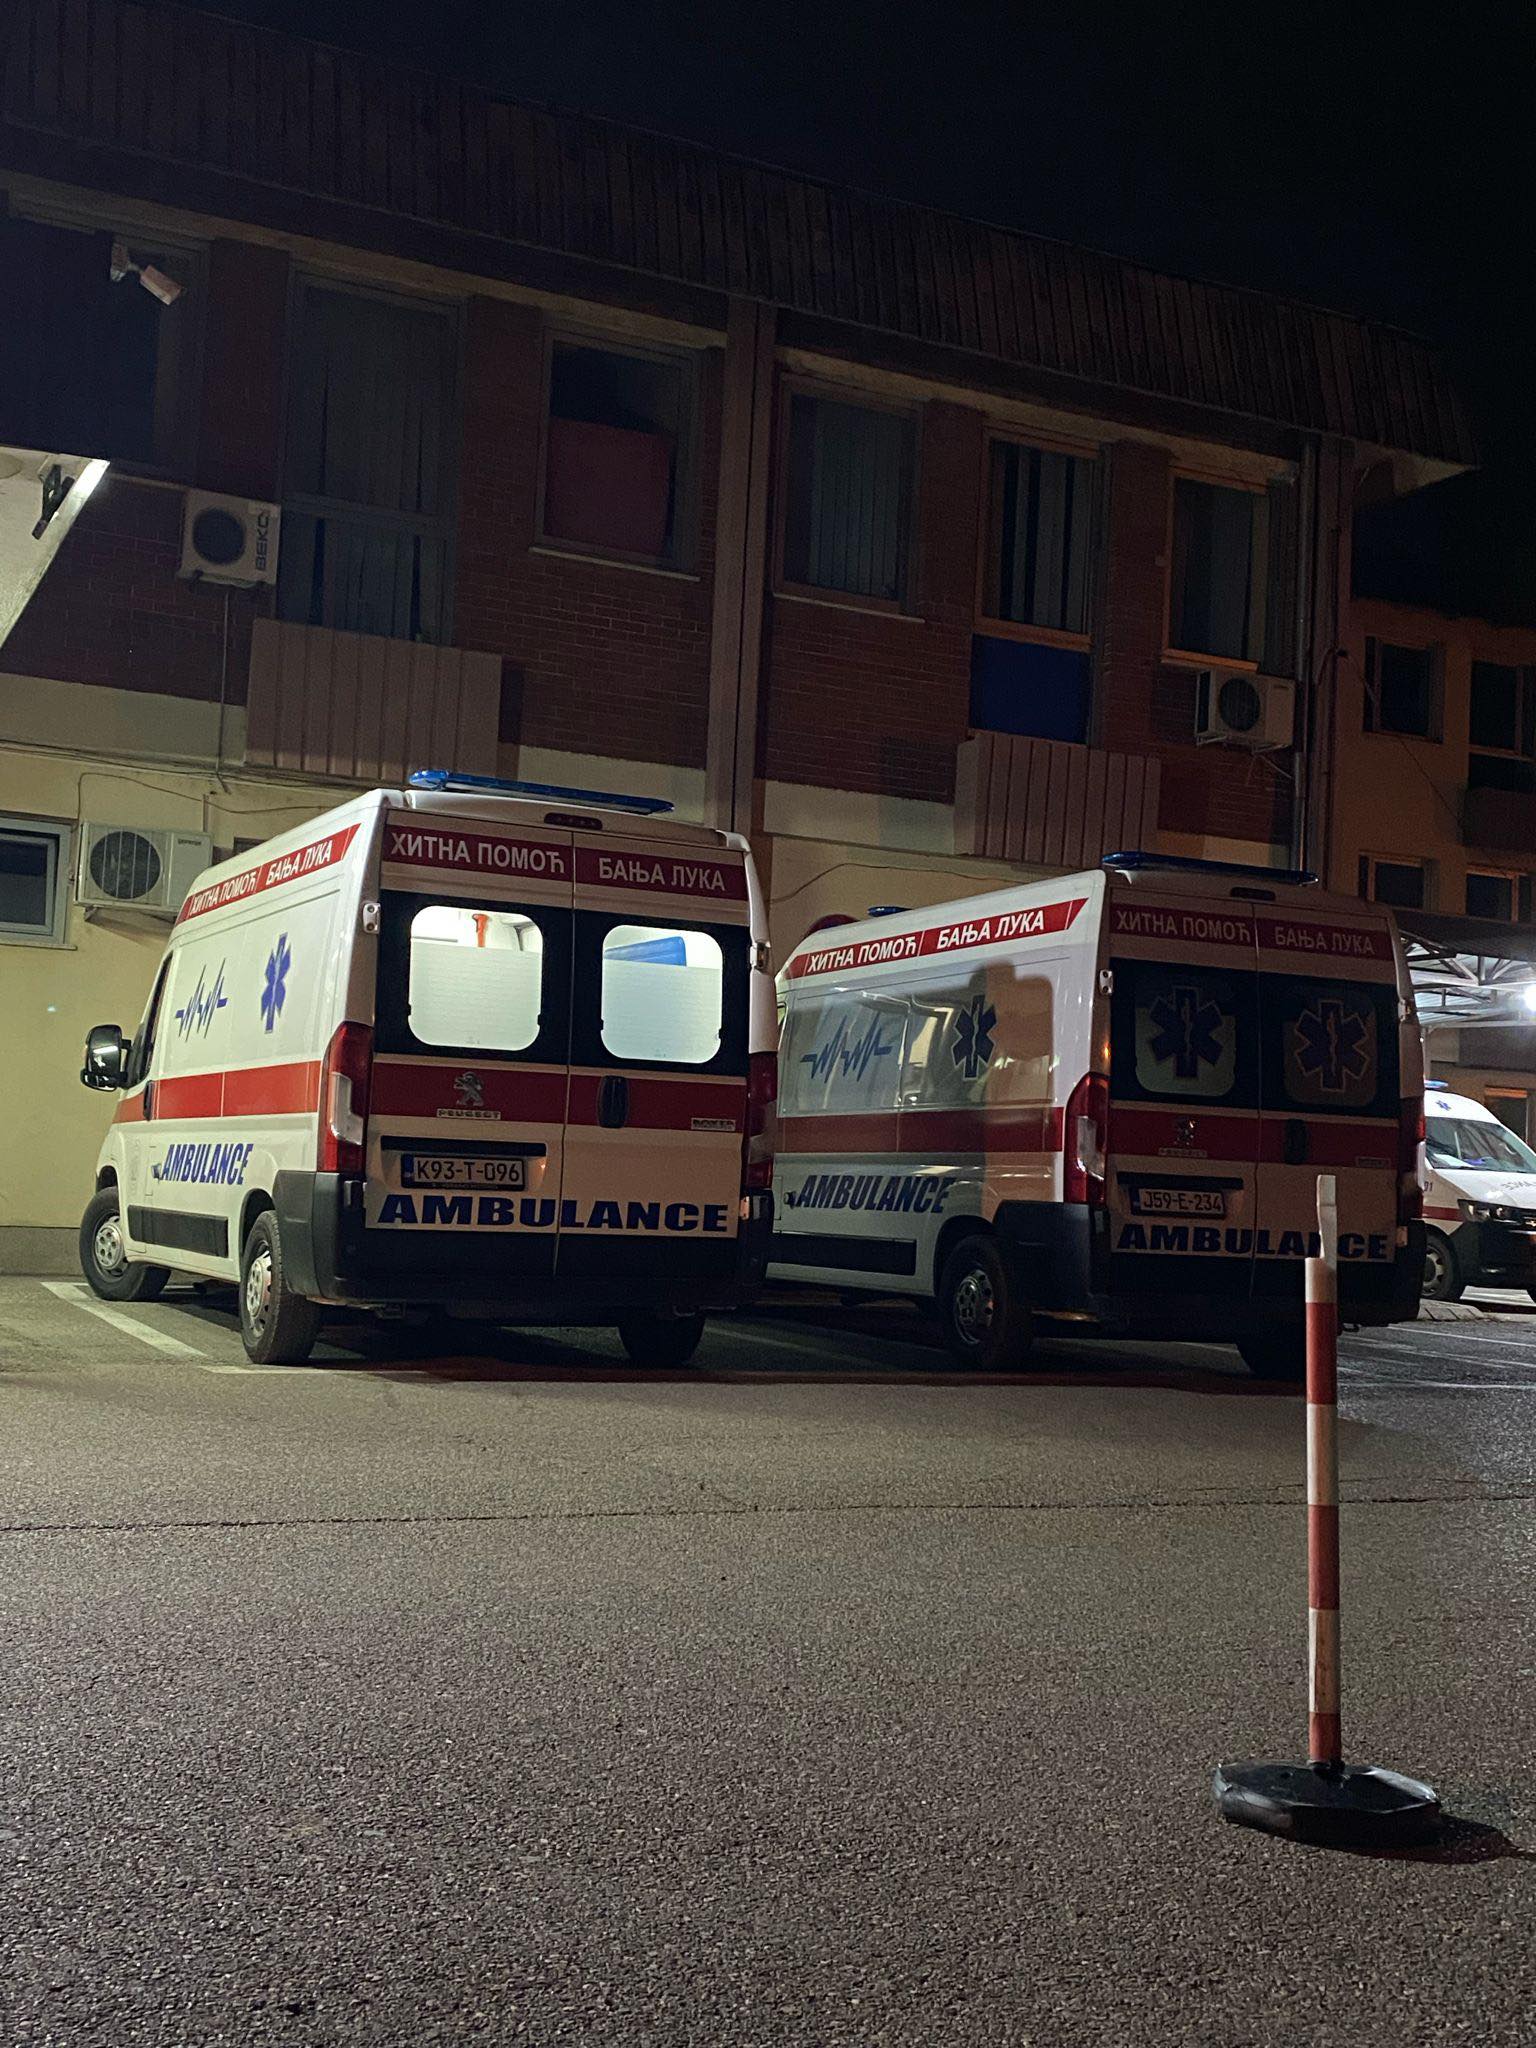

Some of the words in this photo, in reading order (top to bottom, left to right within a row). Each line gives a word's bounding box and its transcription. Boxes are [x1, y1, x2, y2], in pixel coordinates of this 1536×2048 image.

[256, 509, 269, 571] BEKO
[191, 888, 220, 914] ХИТНА
[265, 853, 301, 886] БАЊА
[299, 840, 333, 873] ЛУКА
[391, 833, 471, 863] ХИТНА
[477, 843, 565, 874] ПОМОЋ
[600, 857, 666, 886] БАЊА
[671, 865, 726, 891] ЛУКА
[807, 947, 854, 973] ХИТНА
[857, 935, 917, 963] ПОМОЋ
[936, 920, 991, 950] БАЊА
[994, 909, 1045, 938] ЛУКА
[1116, 910, 1179, 935] ХИТНА
[1183, 916, 1251, 943] ПОМОЋ
[1274, 926, 1328, 950] БАЊА
[1331, 933, 1375, 955] ЛУКА
[162, 1143, 254, 1185] AMBULANCE
[417, 1160, 519, 1182] K93-T-096
[377, 1194, 728, 1231] AMBULANCE
[796, 1175, 957, 1213] AMBULANCE
